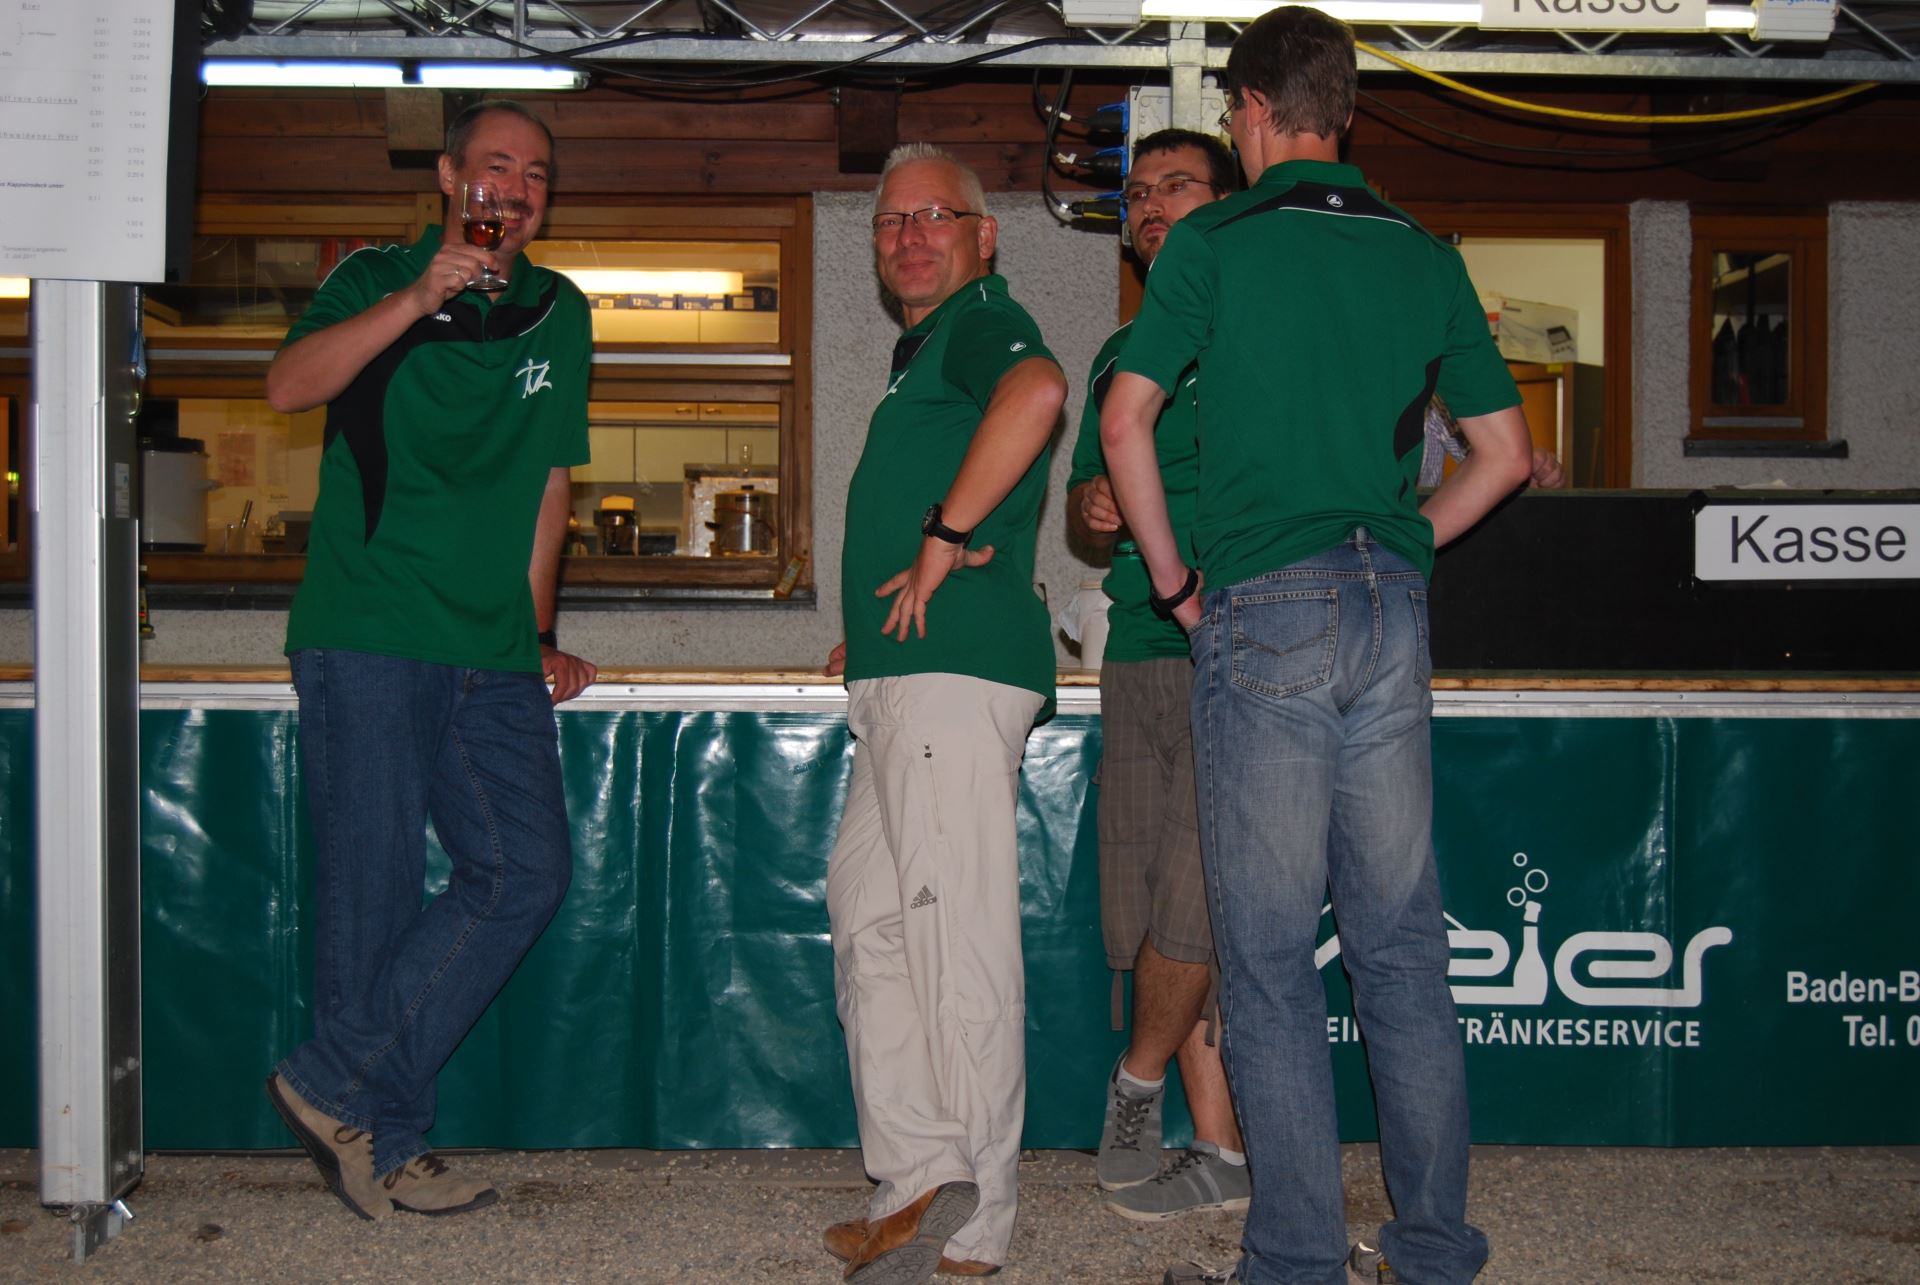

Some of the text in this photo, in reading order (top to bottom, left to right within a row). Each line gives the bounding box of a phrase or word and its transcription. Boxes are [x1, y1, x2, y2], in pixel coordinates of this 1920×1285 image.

[1731, 514, 1907, 564] Kasse
[910, 896, 938, 909] adidas
[1786, 970, 1920, 1003] Baden-B
[1842, 1014, 1896, 1048] Tel.
